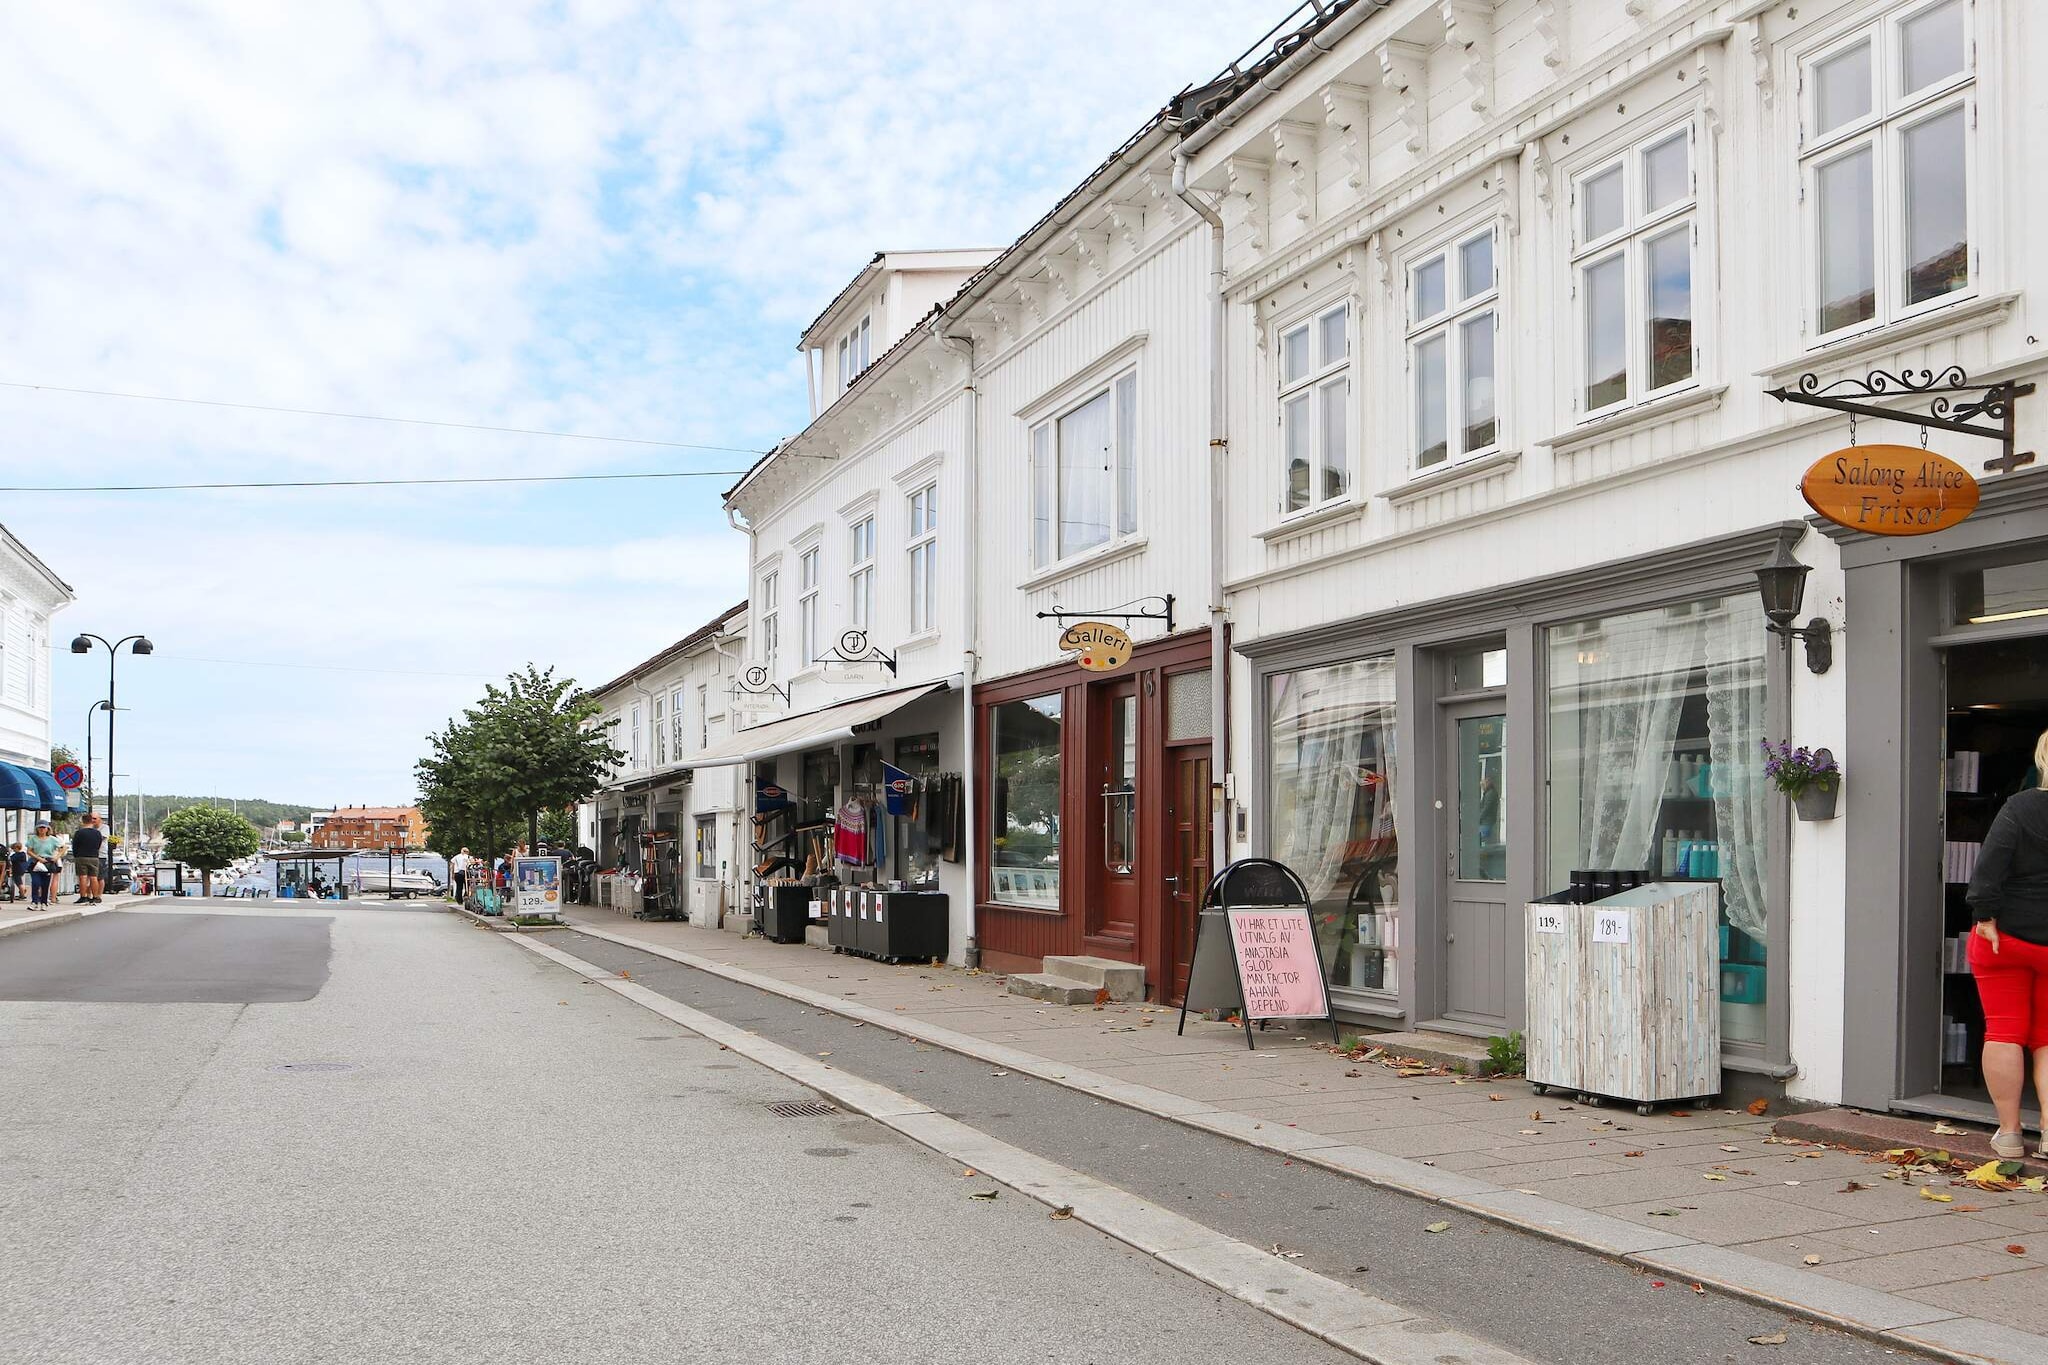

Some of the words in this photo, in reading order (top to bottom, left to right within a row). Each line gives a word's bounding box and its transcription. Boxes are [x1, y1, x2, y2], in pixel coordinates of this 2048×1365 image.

[1834, 457, 1906, 495] Salong
[1913, 461, 1964, 489] Alice
[1065, 628, 1128, 651] Galleri
[1235, 918, 1247, 930] VI
[1249, 918, 1266, 930] HAR
[1268, 918, 1279, 930] ET
[1281, 918, 1304, 931] LITE
[1538, 916, 1561, 929] 119,-
[1240, 931, 1277, 944] UTVALG
[1267, 971, 1301, 985] FACTOR
